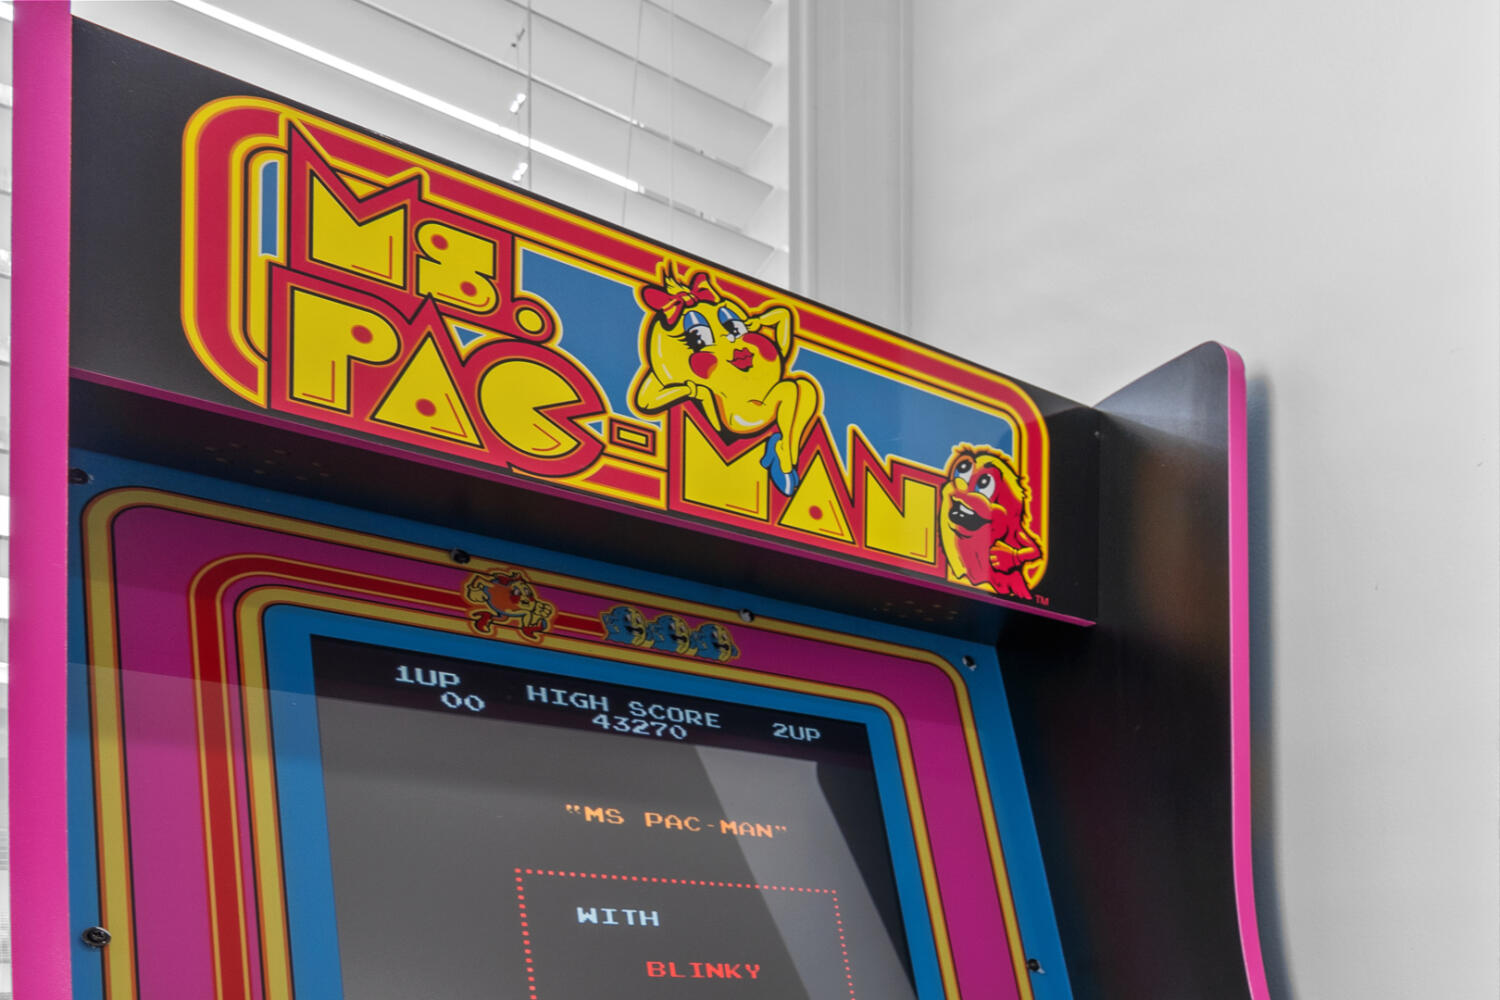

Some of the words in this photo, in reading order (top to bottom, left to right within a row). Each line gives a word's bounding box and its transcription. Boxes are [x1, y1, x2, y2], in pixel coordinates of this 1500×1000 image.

[300, 155, 554, 345] MS.
[394, 665, 461, 689] 1UP
[526, 684, 609, 712] HIGH
[629, 700, 720, 729] SCORE
[592, 713, 687, 740] 43270
[772, 722, 822, 743] 2UP
[576, 906, 660, 927] WITH
[646, 961, 761, 980] BLINKY
